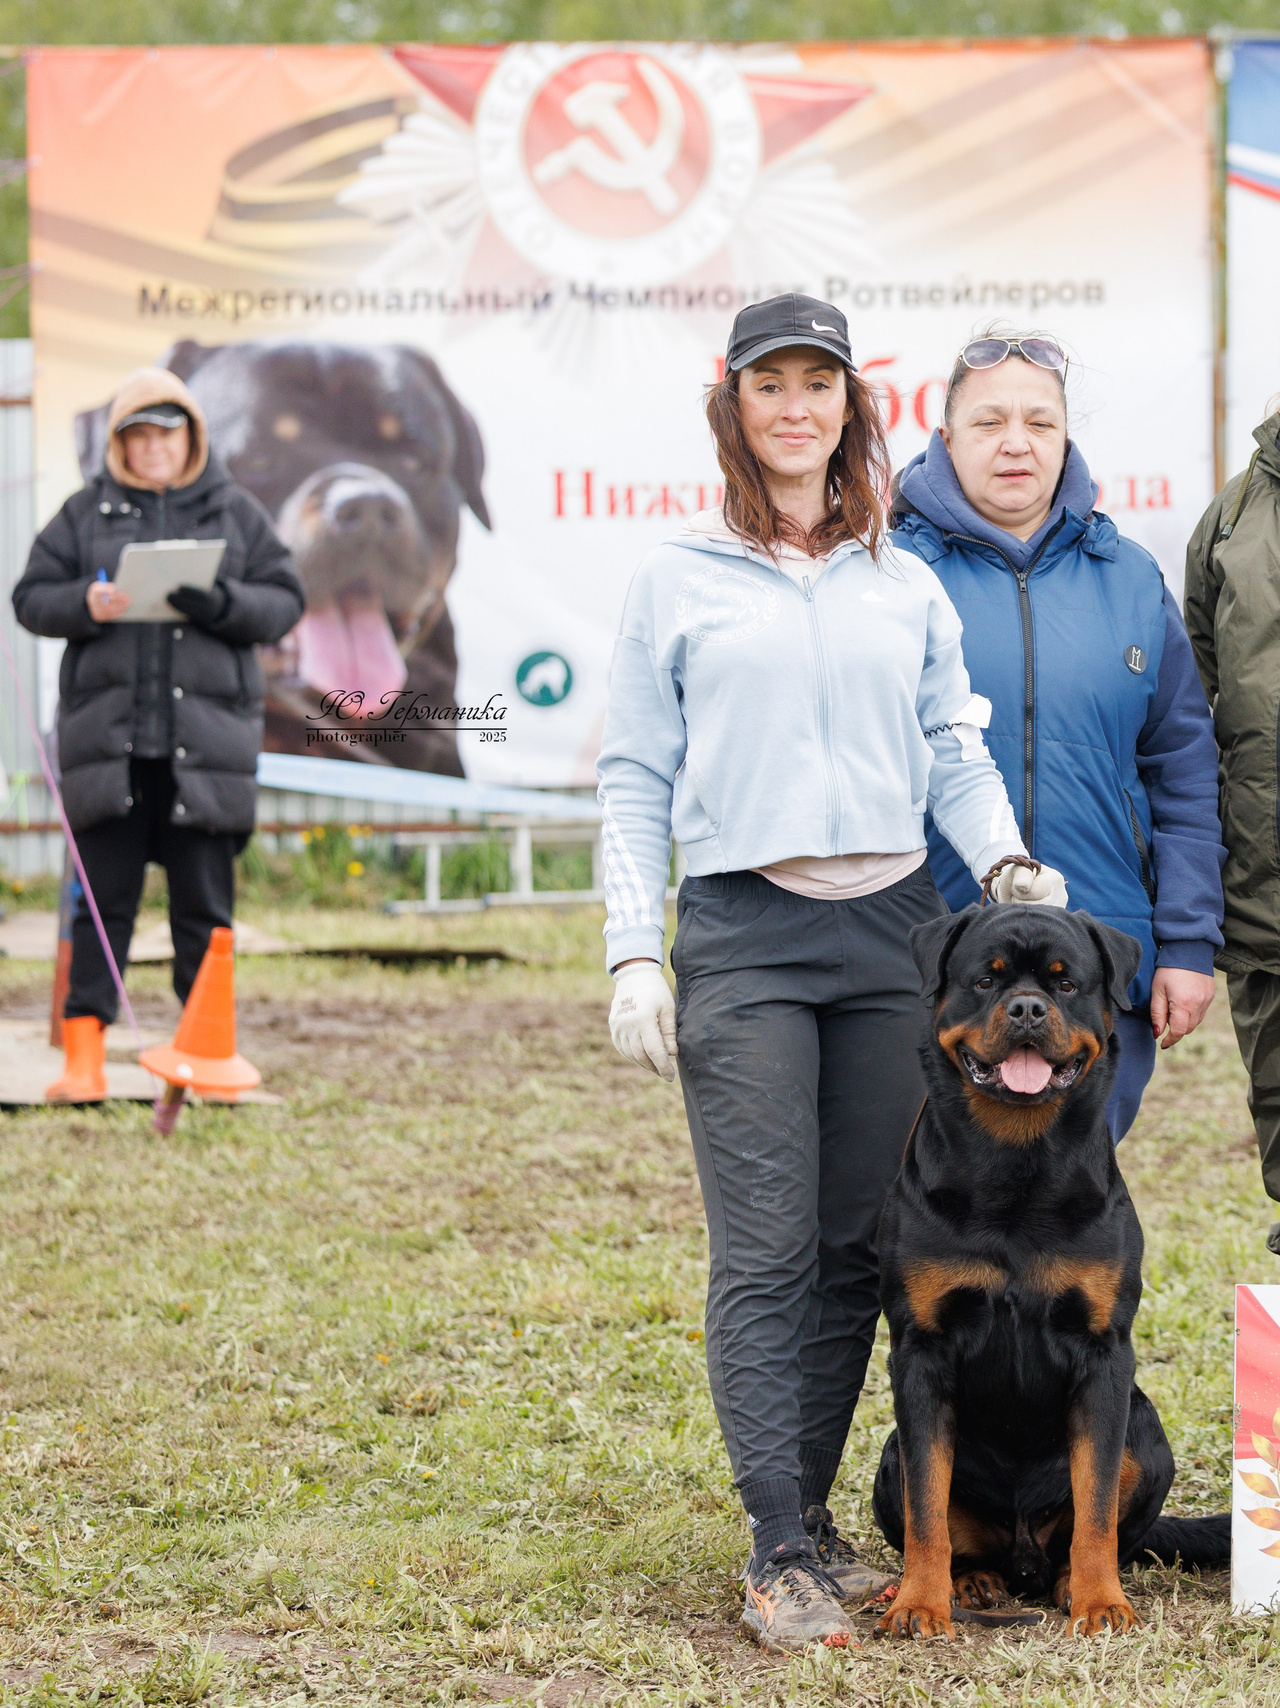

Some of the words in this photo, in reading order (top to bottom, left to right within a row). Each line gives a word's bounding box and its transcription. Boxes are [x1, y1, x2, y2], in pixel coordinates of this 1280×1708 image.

[137, 279, 553, 322] Межрегиональный
[824, 276, 1105, 314] Ротвейлеров
[553, 470, 724, 516] Нижн
[691, 621, 761, 642] ROTTWEILER
